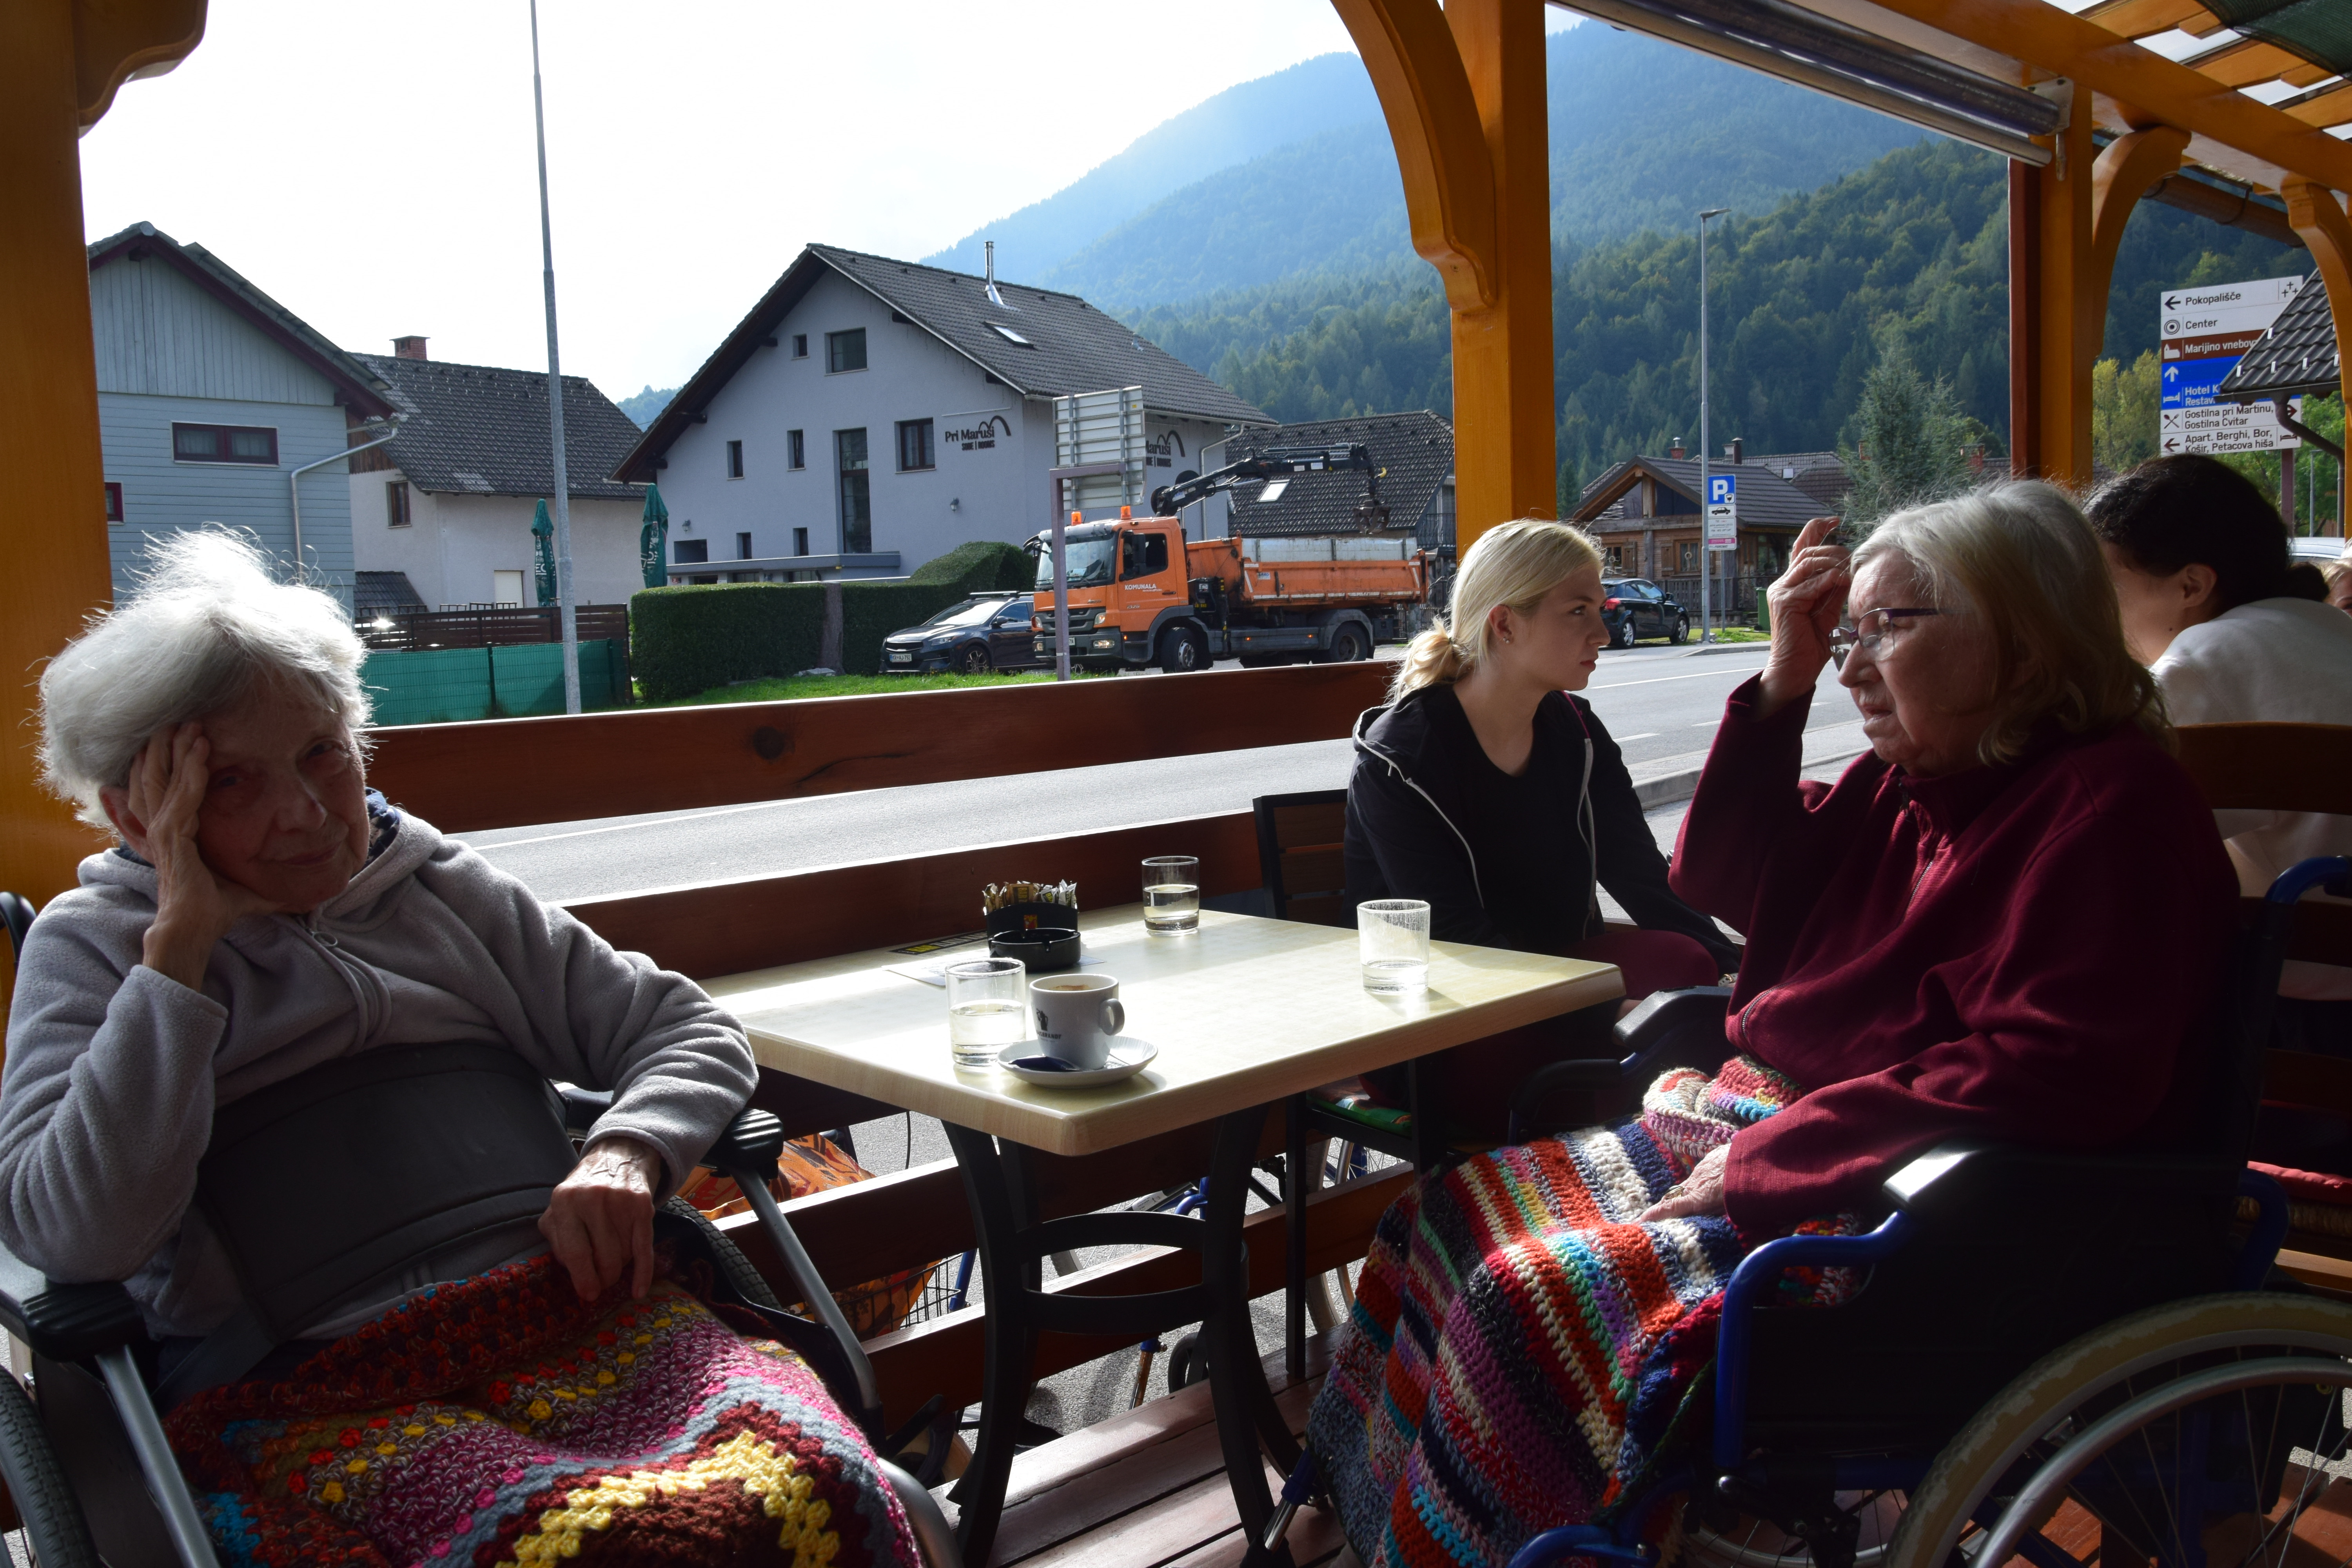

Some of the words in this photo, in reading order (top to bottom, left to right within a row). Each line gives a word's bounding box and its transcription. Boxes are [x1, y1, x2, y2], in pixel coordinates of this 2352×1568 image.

[2185, 292, 2241, 306] Pokopališče
[2185, 319, 2218, 329] Center
[2185, 343, 2220, 354] Marijino
[2185, 386, 2210, 396] Hotel
[2212, 385, 2220, 393] K
[2185, 396, 2215, 407] Restav
[2185, 408, 2220, 419] Gostilna
[2222, 407, 2233, 417] pri
[2236, 405, 2273, 415] Martinu,
[2185, 419, 2220, 429] Gostilna
[2222, 417, 2248, 426] Cvitar
[945, 430, 958, 442] Pri
[2185, 434, 2213, 444] Apart.
[2217, 430, 2250, 441] Berghi,
[2253, 429, 2272, 438] Bor,
[2212, 442, 2252, 452] Petacova
[2255, 438, 2273, 448] hiša
[1713, 480, 1728, 500] P
